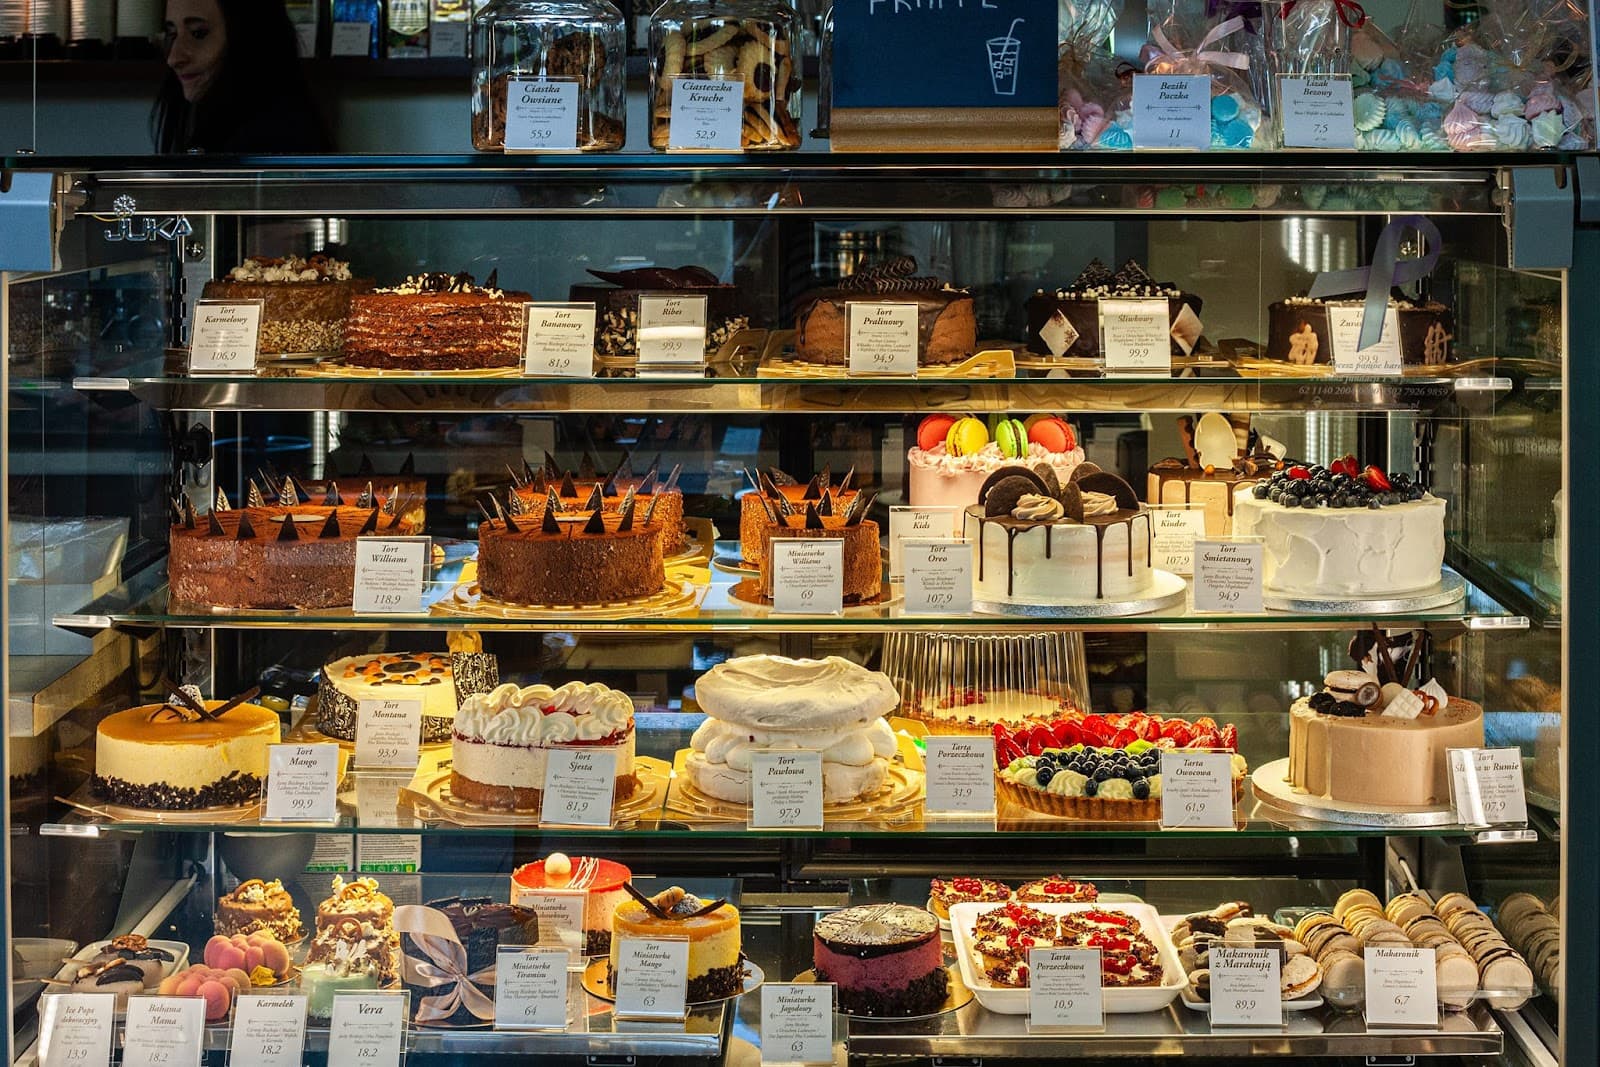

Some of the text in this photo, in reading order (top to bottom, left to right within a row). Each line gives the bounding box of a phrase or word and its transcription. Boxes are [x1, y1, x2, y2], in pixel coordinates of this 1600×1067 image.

[682, 81, 732, 92] Ciasteczka
[1160, 81, 1189, 90] Beziki
[1306, 79, 1329, 87] Lizak
[524, 84, 560, 93] Ciastka
[1303, 88, 1333, 97] Bezowy
[521, 94, 563, 104] Owsiane
[689, 92, 724, 103] Kruche
[1159, 91, 1190, 100] Paczka
[1313, 123, 1329, 133] 7,5
[530, 129, 552, 140] 55,9
[695, 130, 717, 140] 52,9
[1169, 129, 1181, 138] 11
[104, 218, 192, 241] JUKA
[665, 299, 681, 307] Tort
[220, 306, 236, 314] Tort
[662, 308, 683, 316] Ribes
[875, 307, 892, 316] Tort
[554, 311, 571, 319] Tort
[204, 315, 248, 325] Karmelowy
[863, 317, 905, 328] Pralinowy
[540, 320, 583, 331] Bananowy
[661, 341, 682, 352] 99,9
[211, 351, 237, 361] 106,9
[1129, 348, 1149, 358] 99,9
[548, 358, 570, 368] 81,9
[873, 353, 894, 364] 94,9
[913, 512, 930, 520] Tort
[1166, 511, 1181, 519] Tort
[913, 521, 930, 530] Kids
[1160, 519, 1187, 528] Kinder
[382, 544, 399, 553] Tort
[929, 545, 947, 553] Tort
[1219, 544, 1237, 553] Tort
[371, 554, 408, 563] Williams
[792, 557, 821, 565] Williams
[927, 554, 948, 562] Oreo
[1166, 555, 1190, 565] 107,9
[1203, 552, 1252, 565] Śmietanowy
[374, 594, 401, 605] 118,9
[801, 590, 814, 600] 69
[925, 594, 953, 604] 107,9
[1218, 591, 1240, 602] 94,9
[383, 701, 399, 709] Tort
[372, 710, 407, 719] Montana
[296, 747, 313, 756] Tort
[951, 743, 972, 751] Tarta
[574, 752, 592, 760] Tort
[937, 750, 985, 759] Porzeczkowa
[1477, 752, 1495, 761] Tort
[289, 757, 318, 768] Mango
[777, 756, 795, 765] Tort
[1183, 758, 1204, 767] Tarta
[568, 761, 593, 772] Sjesta
[1493, 762, 1520, 771] Rumie
[1176, 768, 1212, 776] Owocowa
[292, 799, 314, 809] 99,9
[566, 801, 589, 812] 81,9
[1185, 802, 1206, 812] 61,9
[1481, 800, 1506, 811] 07,9
[778, 807, 801, 818] 97,9
[645, 943, 660, 951] Tort
[632, 951, 672, 960] Miniaturka
[1050, 952, 1071, 961] Tarta
[1216, 949, 1270, 959] Makaronik
[1375, 949, 1420, 958] Makaronik
[512, 962, 551, 970] Miniaturka
[639, 960, 663, 968] Mango
[1036, 962, 1085, 971] Porzeczkowa
[1223, 959, 1272, 972] Marakują
[516, 971, 547, 979] Tiramisu
[789, 987, 804, 995] Tort
[256, 999, 295, 1008] Karmelek
[643, 995, 656, 1006] 63
[1053, 999, 1074, 1009] 10,9
[1235, 999, 1257, 1010] 89,9
[1394, 994, 1411, 1006] 6,7
[148, 1003, 182, 1013] Bahama
[358, 1003, 384, 1015] Vera
[524, 1005, 538, 1016] 64
[780, 1004, 813, 1013] Jagodowy
[150, 1016, 177, 1025] Mama
[260, 1045, 282, 1056] 18,2
[791, 1040, 804, 1052] 63
[66, 1048, 88, 1060] 13,9
[148, 1052, 169, 1063] 18,2
[357, 1048, 378, 1058] 18,2
